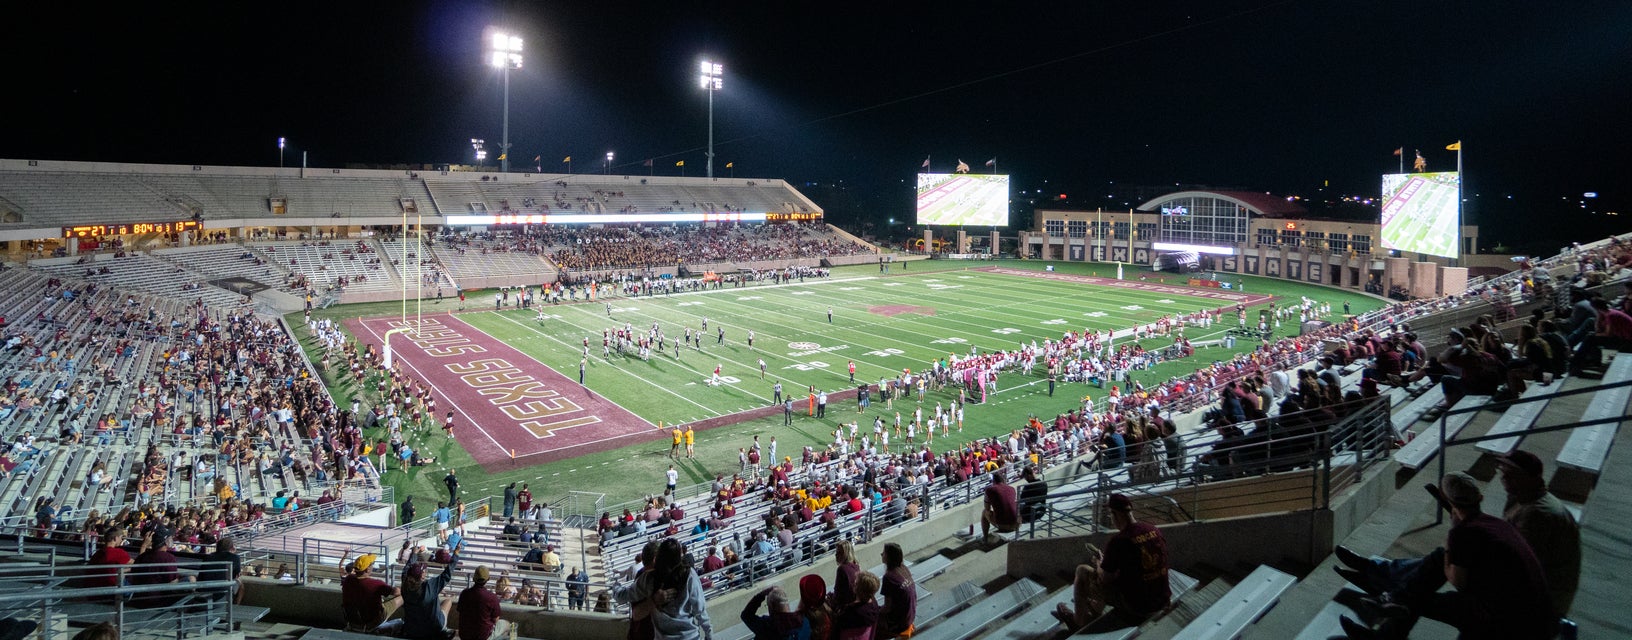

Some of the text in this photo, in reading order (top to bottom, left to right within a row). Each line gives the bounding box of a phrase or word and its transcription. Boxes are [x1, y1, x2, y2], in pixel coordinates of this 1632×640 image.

[91, 225, 105, 236] 27
[119, 227, 127, 235] 10
[133, 223, 153, 234] 8:04
[175, 221, 184, 232] 13
[1072, 246, 1321, 281] TEXA STATE
[786, 360, 831, 371] 20
[387, 318, 603, 439] TEXAS STATE
